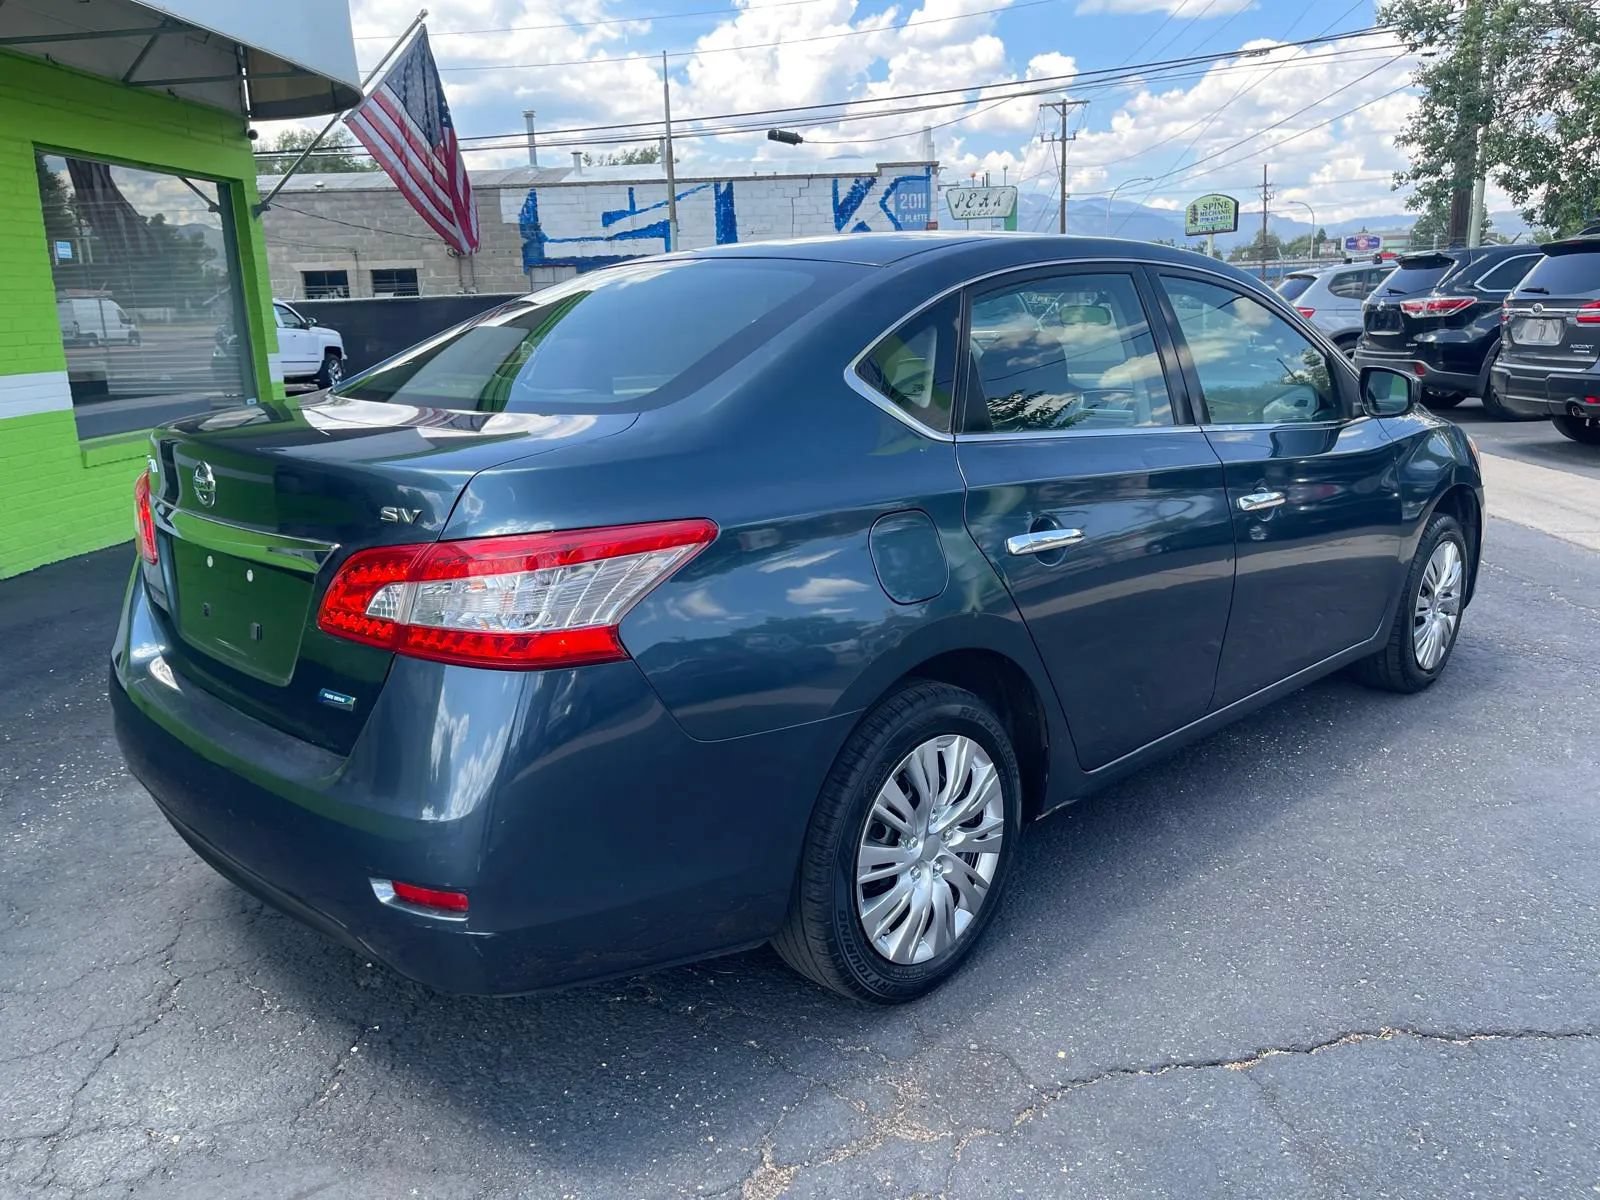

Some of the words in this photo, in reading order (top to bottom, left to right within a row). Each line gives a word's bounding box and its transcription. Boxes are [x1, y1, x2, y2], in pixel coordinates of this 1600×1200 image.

[900, 193, 926, 209] 2011
[954, 191, 1006, 209] PEAK
[1202, 200, 1230, 211] SPINE
[905, 213, 928, 223] PLATTE
[1200, 208, 1232, 217] MECHANIC
[380, 506, 423, 525] SV
